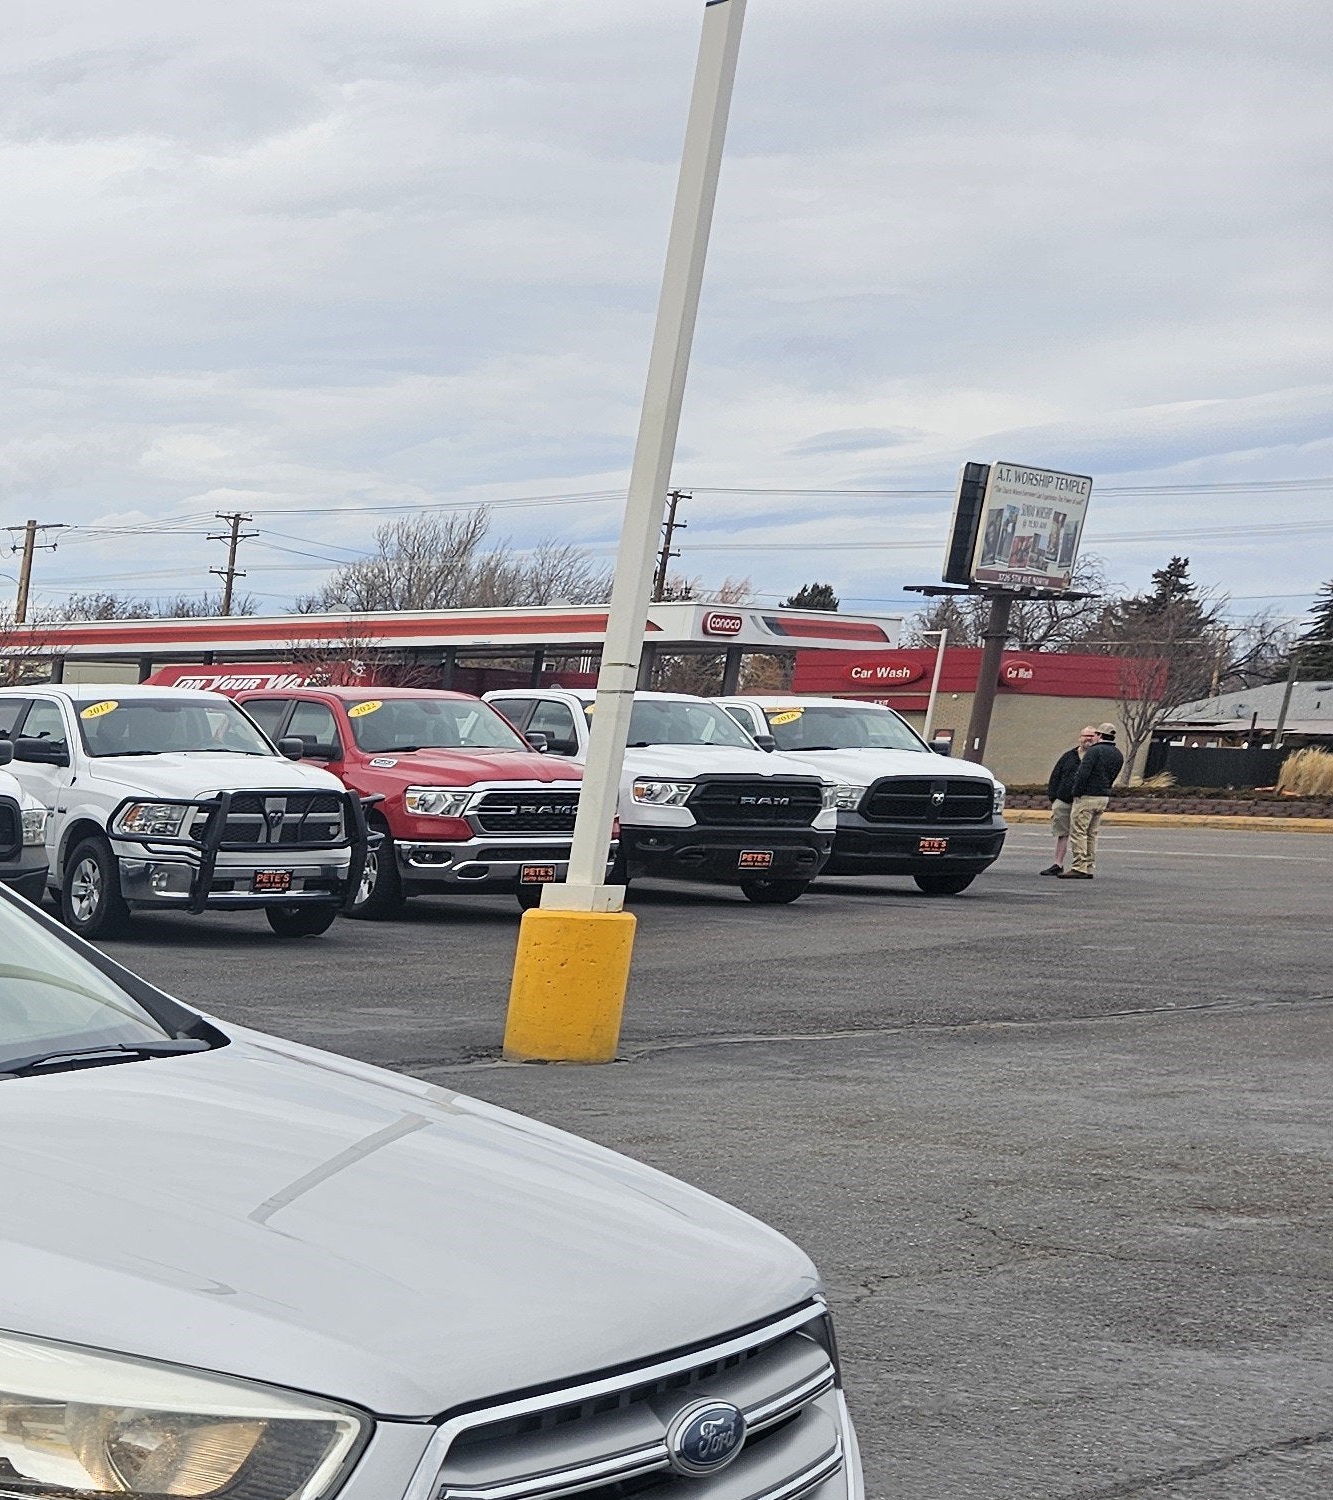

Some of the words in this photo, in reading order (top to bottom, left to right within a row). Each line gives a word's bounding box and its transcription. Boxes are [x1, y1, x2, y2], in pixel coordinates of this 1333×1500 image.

[1014, 470, 1054, 488] WORSHIP
[1055, 476, 1087, 495] TEMPLE
[711, 617, 741, 630] conoco
[851, 667, 873, 679] Car
[877, 667, 911, 678] Wash
[1007, 667, 1017, 679] Car
[1017, 667, 1033, 679] Wash
[88, 702, 110, 716] 2017
[740, 796, 789, 805] RAM
[520, 805, 572, 814] RAM
[741, 853, 771, 862] PETE'S
[256, 873, 290, 882] PETE'S
[523, 867, 554, 876] PETE'S
[699, 1418, 737, 1458] Ford
